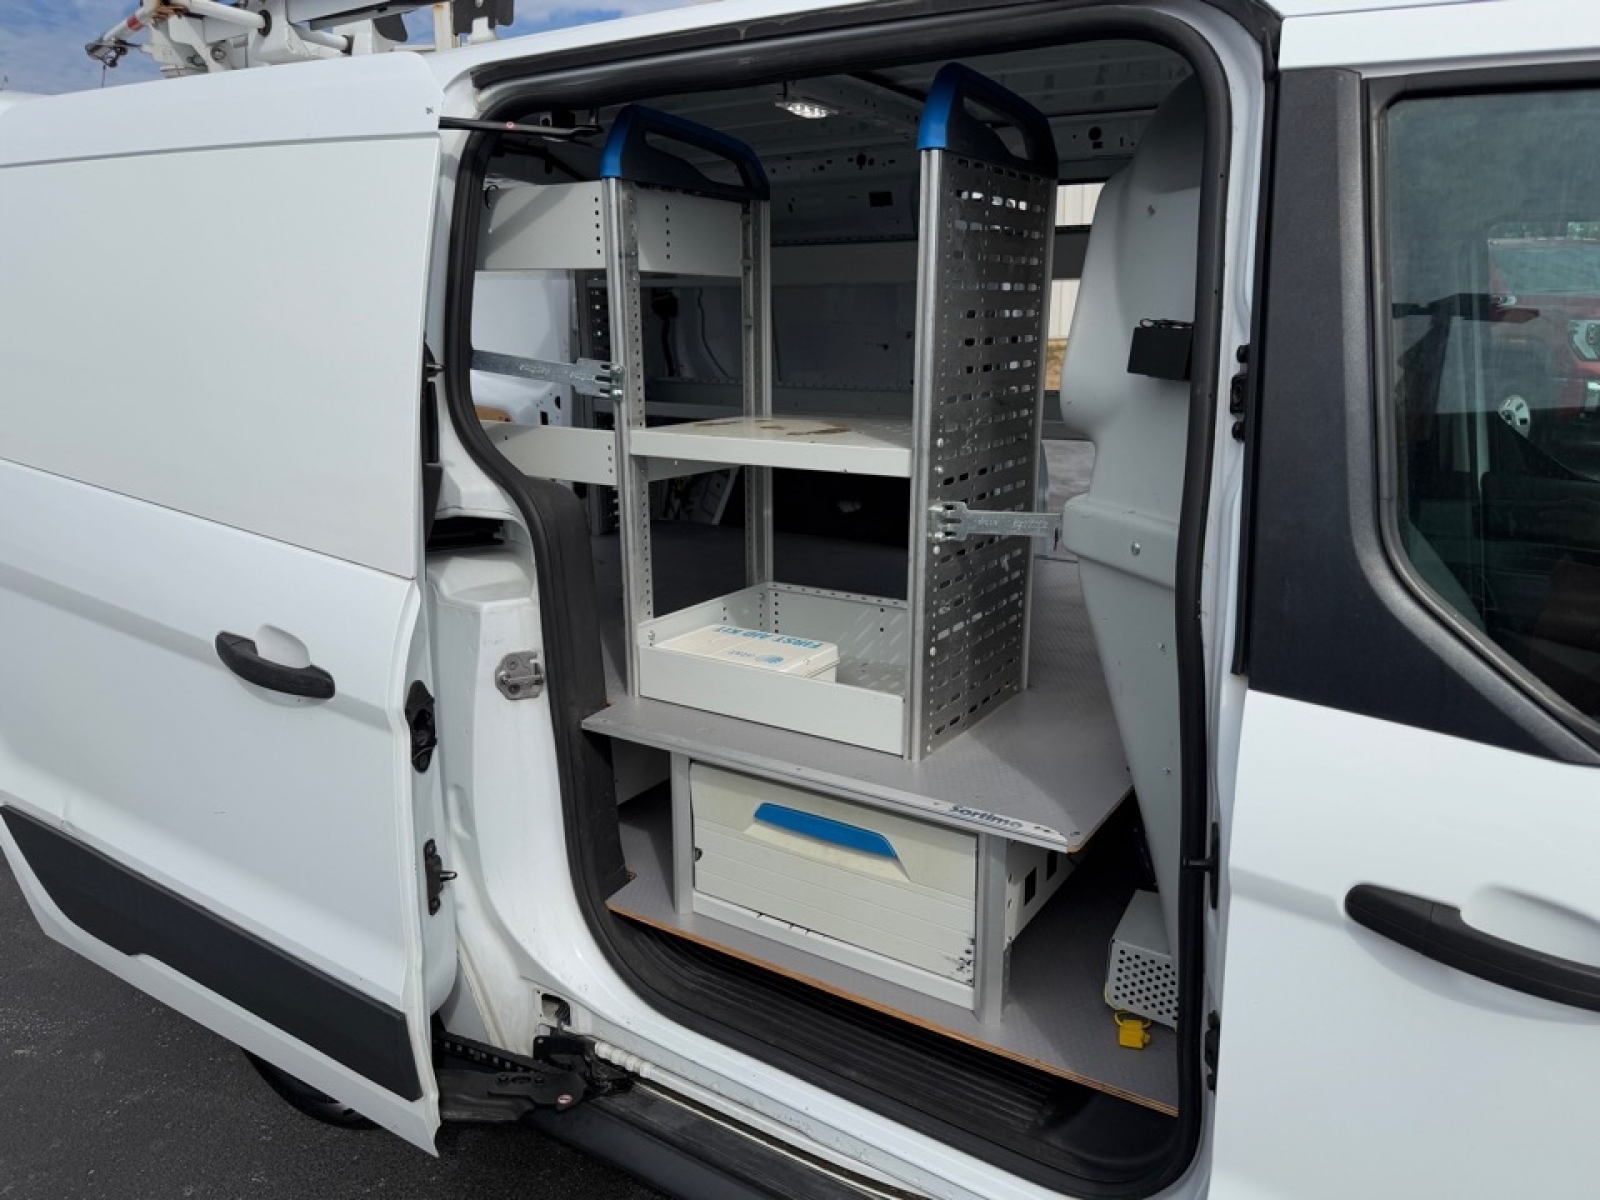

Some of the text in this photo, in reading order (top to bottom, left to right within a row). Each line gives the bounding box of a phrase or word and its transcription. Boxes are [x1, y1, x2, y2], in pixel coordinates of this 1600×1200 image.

[714, 626, 823, 649] FIRST AID KIT
[951, 804, 1023, 829] Sortimo
